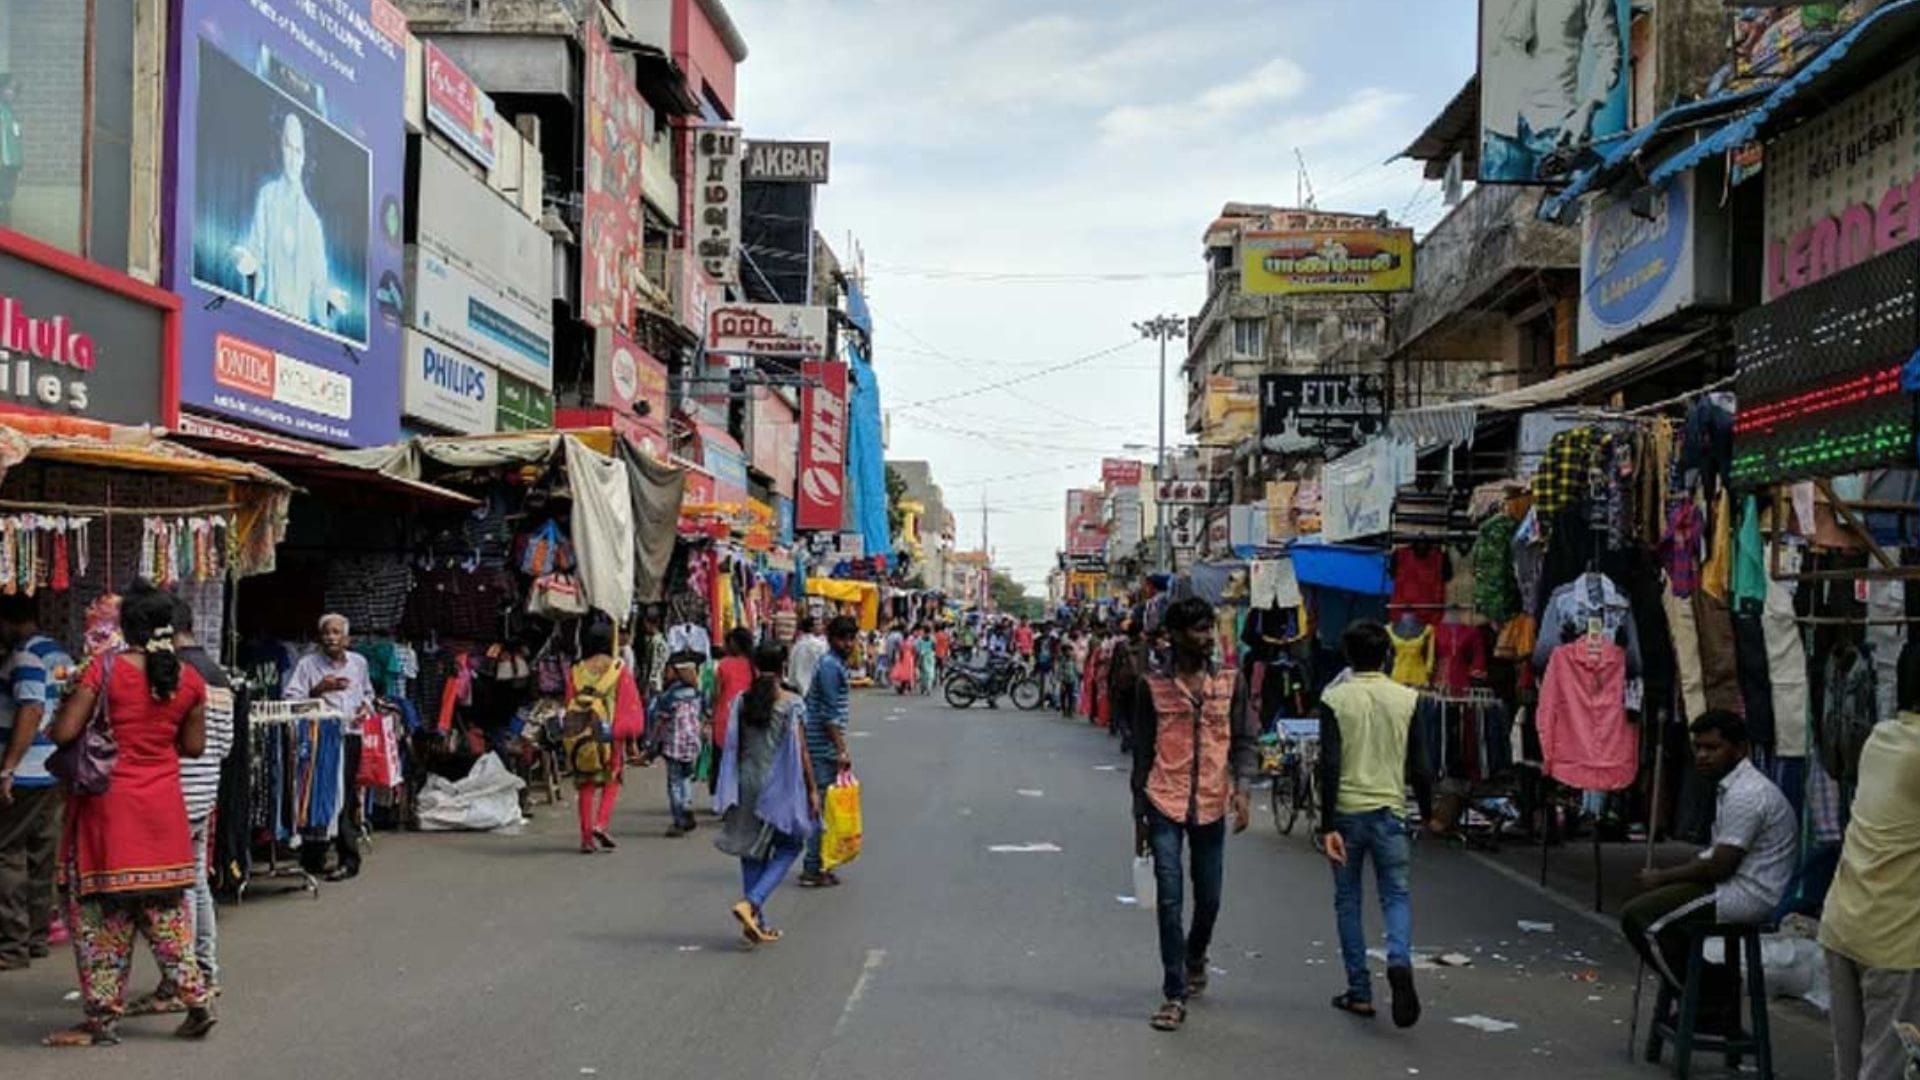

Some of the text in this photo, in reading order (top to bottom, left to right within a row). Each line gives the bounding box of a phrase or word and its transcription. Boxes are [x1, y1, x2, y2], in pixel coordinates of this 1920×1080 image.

[750, 148, 826, 178] AKBAR
[219, 346, 270, 387] ONIDA
[423, 347, 486, 402] PHILIPS
